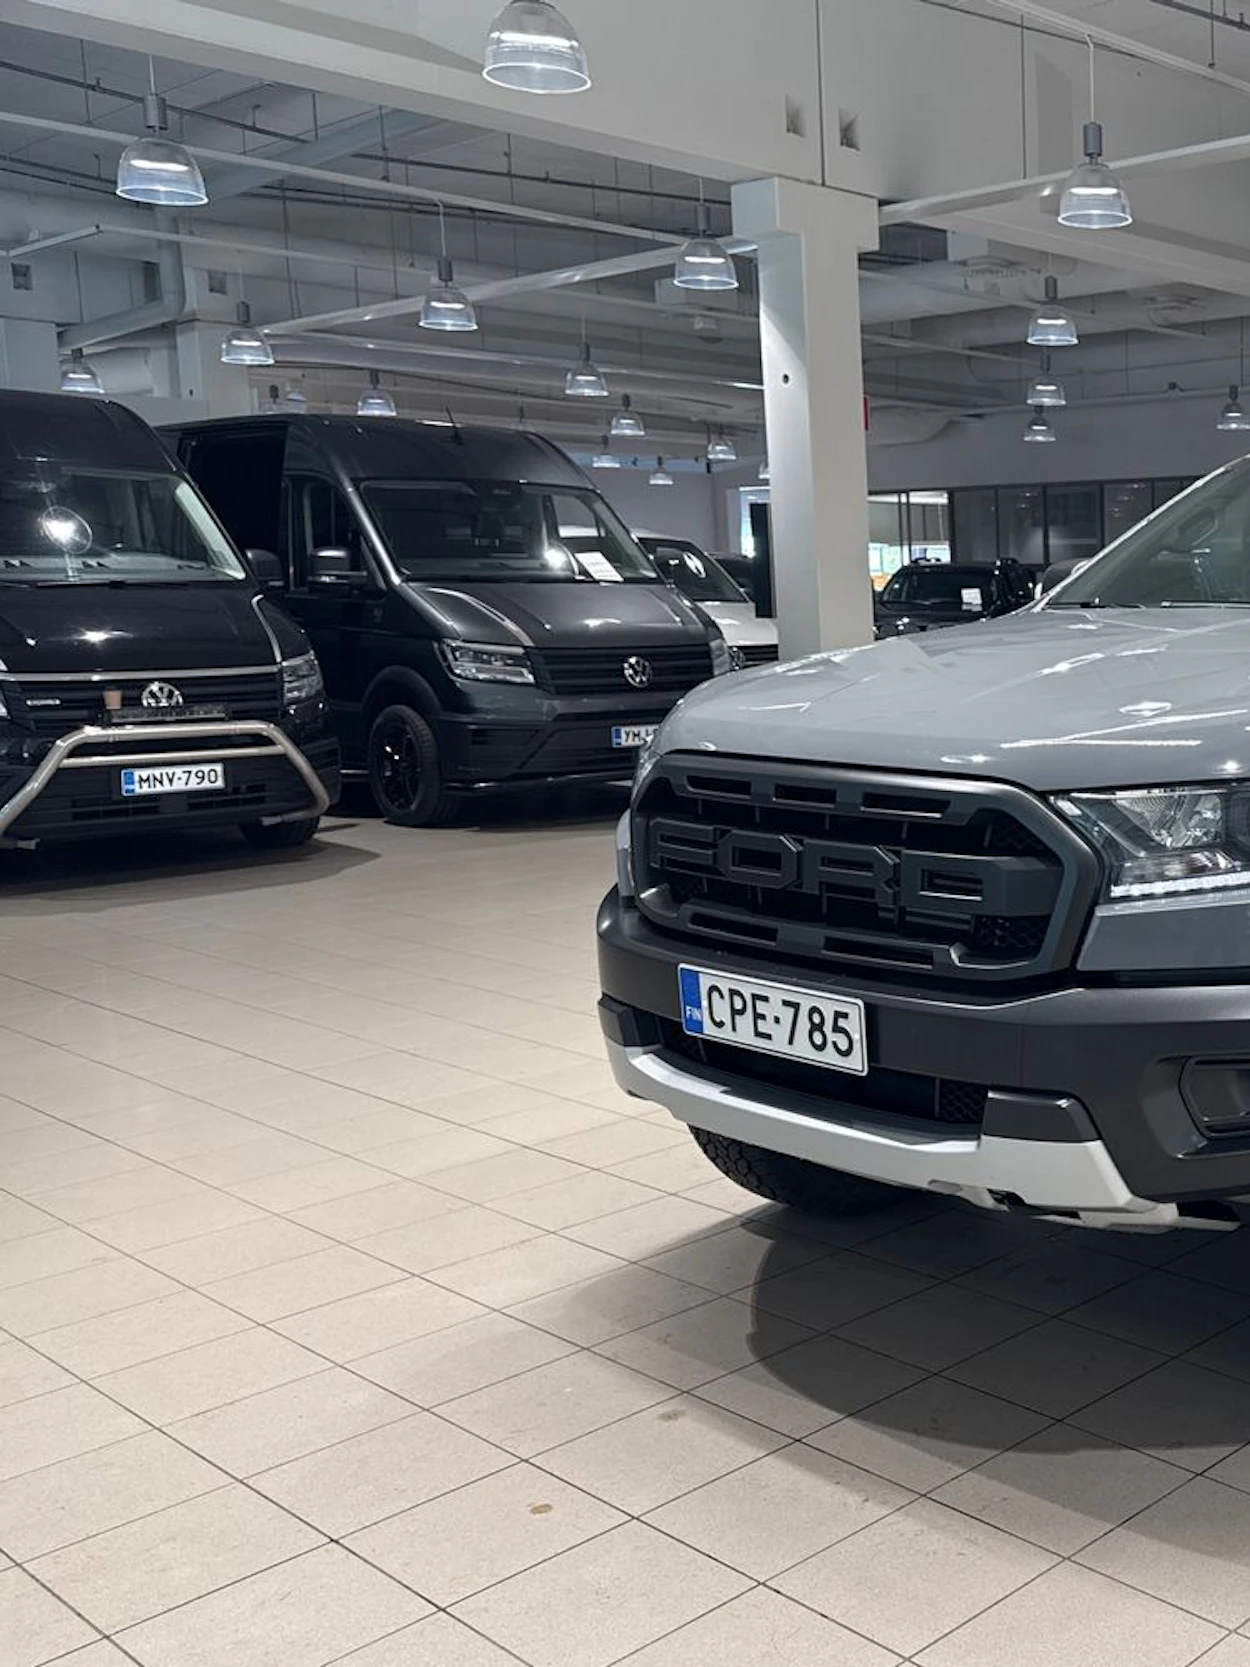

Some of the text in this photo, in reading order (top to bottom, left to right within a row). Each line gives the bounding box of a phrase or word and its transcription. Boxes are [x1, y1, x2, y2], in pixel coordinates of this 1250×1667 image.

[138, 768, 218, 789] MNV-790
[650, 817, 1025, 924] FORD
[707, 984, 853, 1057] CPE-785
